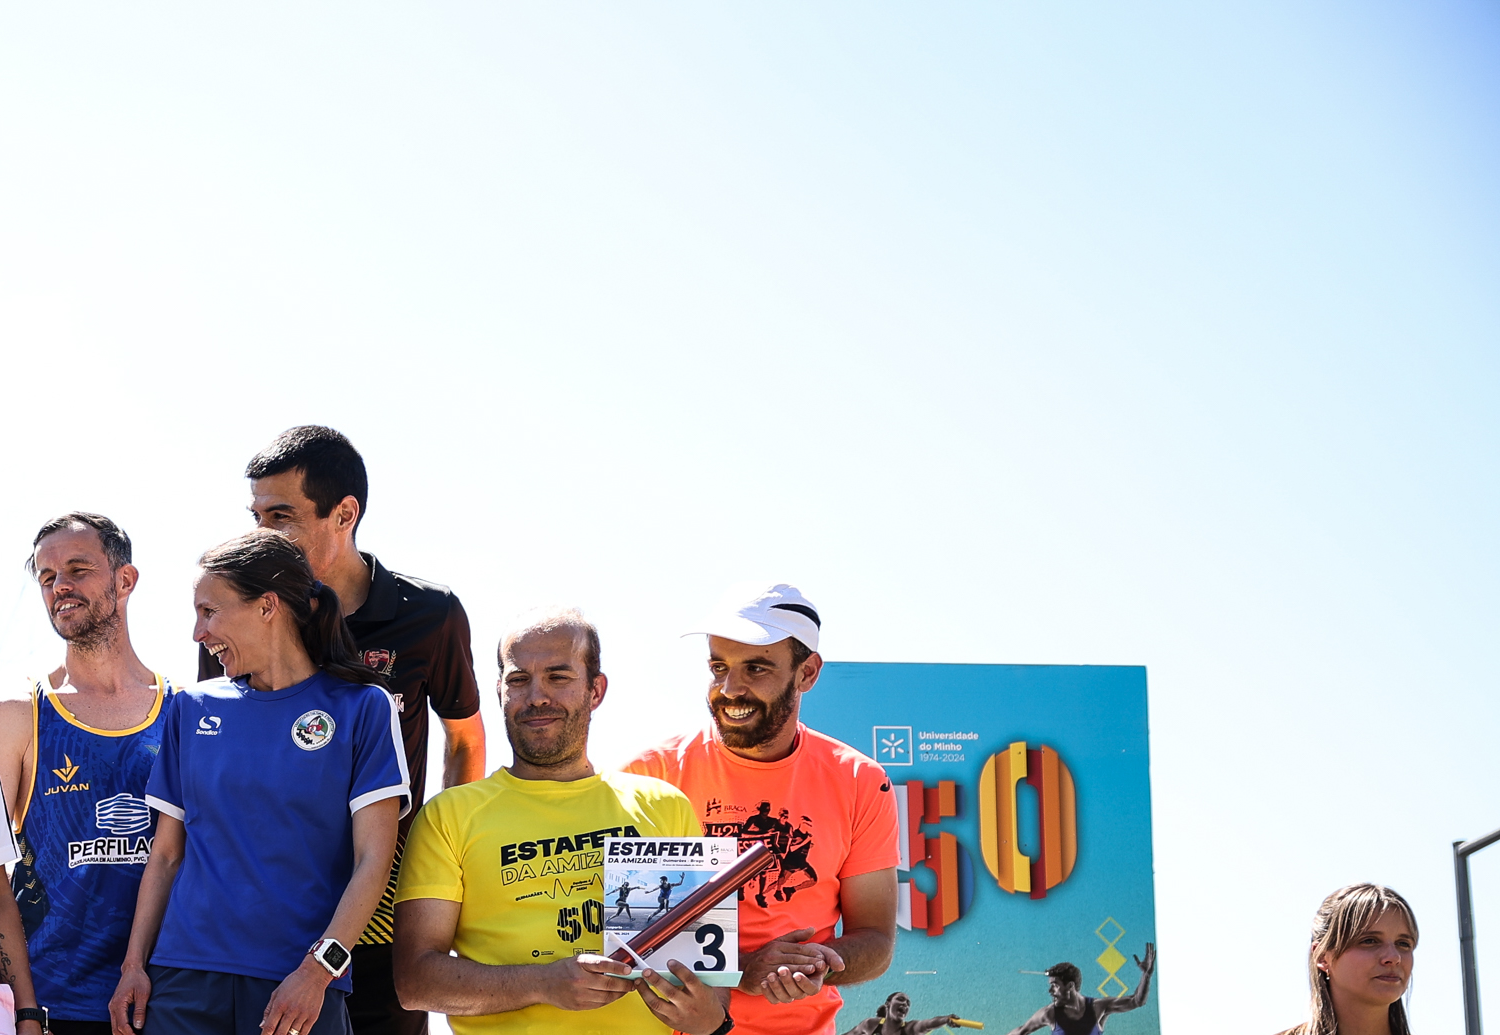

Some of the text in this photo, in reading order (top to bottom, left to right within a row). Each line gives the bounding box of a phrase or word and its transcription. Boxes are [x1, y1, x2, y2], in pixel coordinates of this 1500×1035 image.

[918, 731, 979, 741] Universidade
[919, 742, 962, 751] do Minho
[919, 753, 965, 763] 1974-2024
[44, 783, 90, 796] JUVAN
[69, 837, 155, 861] PERFILA
[608, 842, 704, 856] ESTAFETA
[501, 850, 604, 886] DA AMIZ
[556, 899, 604, 943] 50
[693, 923, 727, 972] 3
